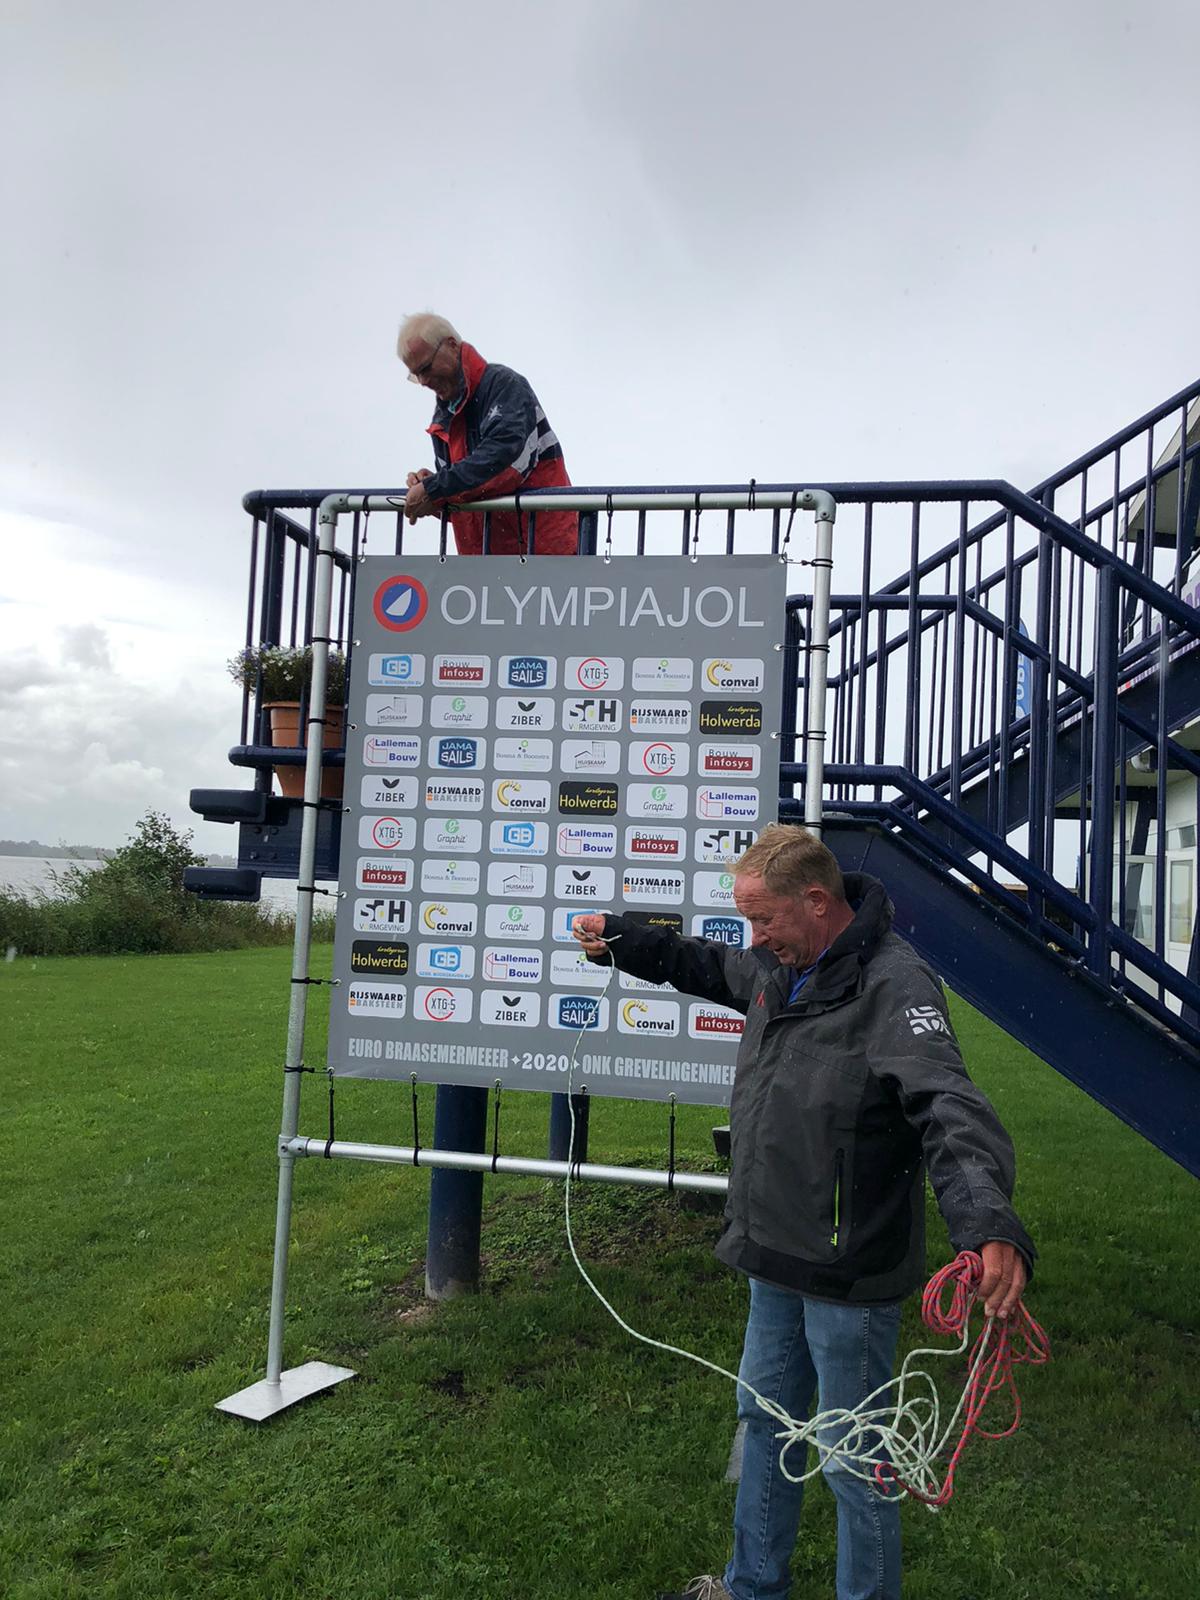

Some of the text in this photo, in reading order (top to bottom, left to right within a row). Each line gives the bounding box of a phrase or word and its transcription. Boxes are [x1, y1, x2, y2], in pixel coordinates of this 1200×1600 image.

[440, 585, 765, 628] OLYMPIAJOL
[442, 660, 470, 668] Bouw
[511, 660, 543, 670] JAMA
[443, 668, 480, 680] infosys
[510, 670, 544, 683] SAILS
[720, 677, 759, 687] conval
[631, 708, 688, 718] RIJSWAARD
[510, 715, 542, 726] ZIBER
[638, 716, 688, 725] BAKSTEEN
[700, 713, 761, 728] Holwerda
[374, 739, 418, 748] Lalleman
[441, 740, 472, 750] JAMA
[388, 753, 418, 762] Bouw
[440, 750, 474, 764] SAILS
[708, 749, 738, 758] Bouw
[710, 758, 750, 768] infosys
[427, 786, 482, 796] RIJSWAARD
[708, 792, 756, 800] Lalleman
[375, 792, 404, 802] ZIBER
[559, 794, 617, 809] Holwerda
[510, 798, 546, 808] conval
[643, 801, 673, 812] Graphit
[724, 806, 756, 816] Bouw
[568, 829, 614, 838] Lalleman
[635, 831, 664, 840] Bouw
[436, 834, 467, 844] Graphit
[583, 843, 614, 853] Bouw
[636, 840, 676, 852] infosys
[366, 862, 393, 871] Bouw
[366, 871, 403, 882] infosys
[624, 877, 682, 888] RIJSWAARD
[564, 884, 597, 896] ZIBER
[630, 886, 681, 896] BAKSTEEN
[710, 888, 735, 900] Graph
[436, 922, 472, 932] conval
[500, 921, 530, 932] Graphit
[706, 922, 740, 931] JAMA
[352, 953, 408, 968] Holwerda
[494, 954, 540, 964] Lalleman
[508, 968, 539, 978] Bouw
[350, 991, 404, 1001] RIJSWAARD
[356, 1000, 403, 1009] BAKSTEEN
[562, 1001, 594, 1010] JAMA
[495, 1010, 527, 1022] ZIBER
[700, 1009, 730, 1018] Bouw
[636, 1020, 674, 1030] conval
[700, 1017, 741, 1030] infosys
[348, 1037, 383, 1059] EURO
[521, 1052, 569, 1073] 2020
[582, 1053, 611, 1076] ONK
[614, 1056, 737, 1086] GREVELINGENMEE
